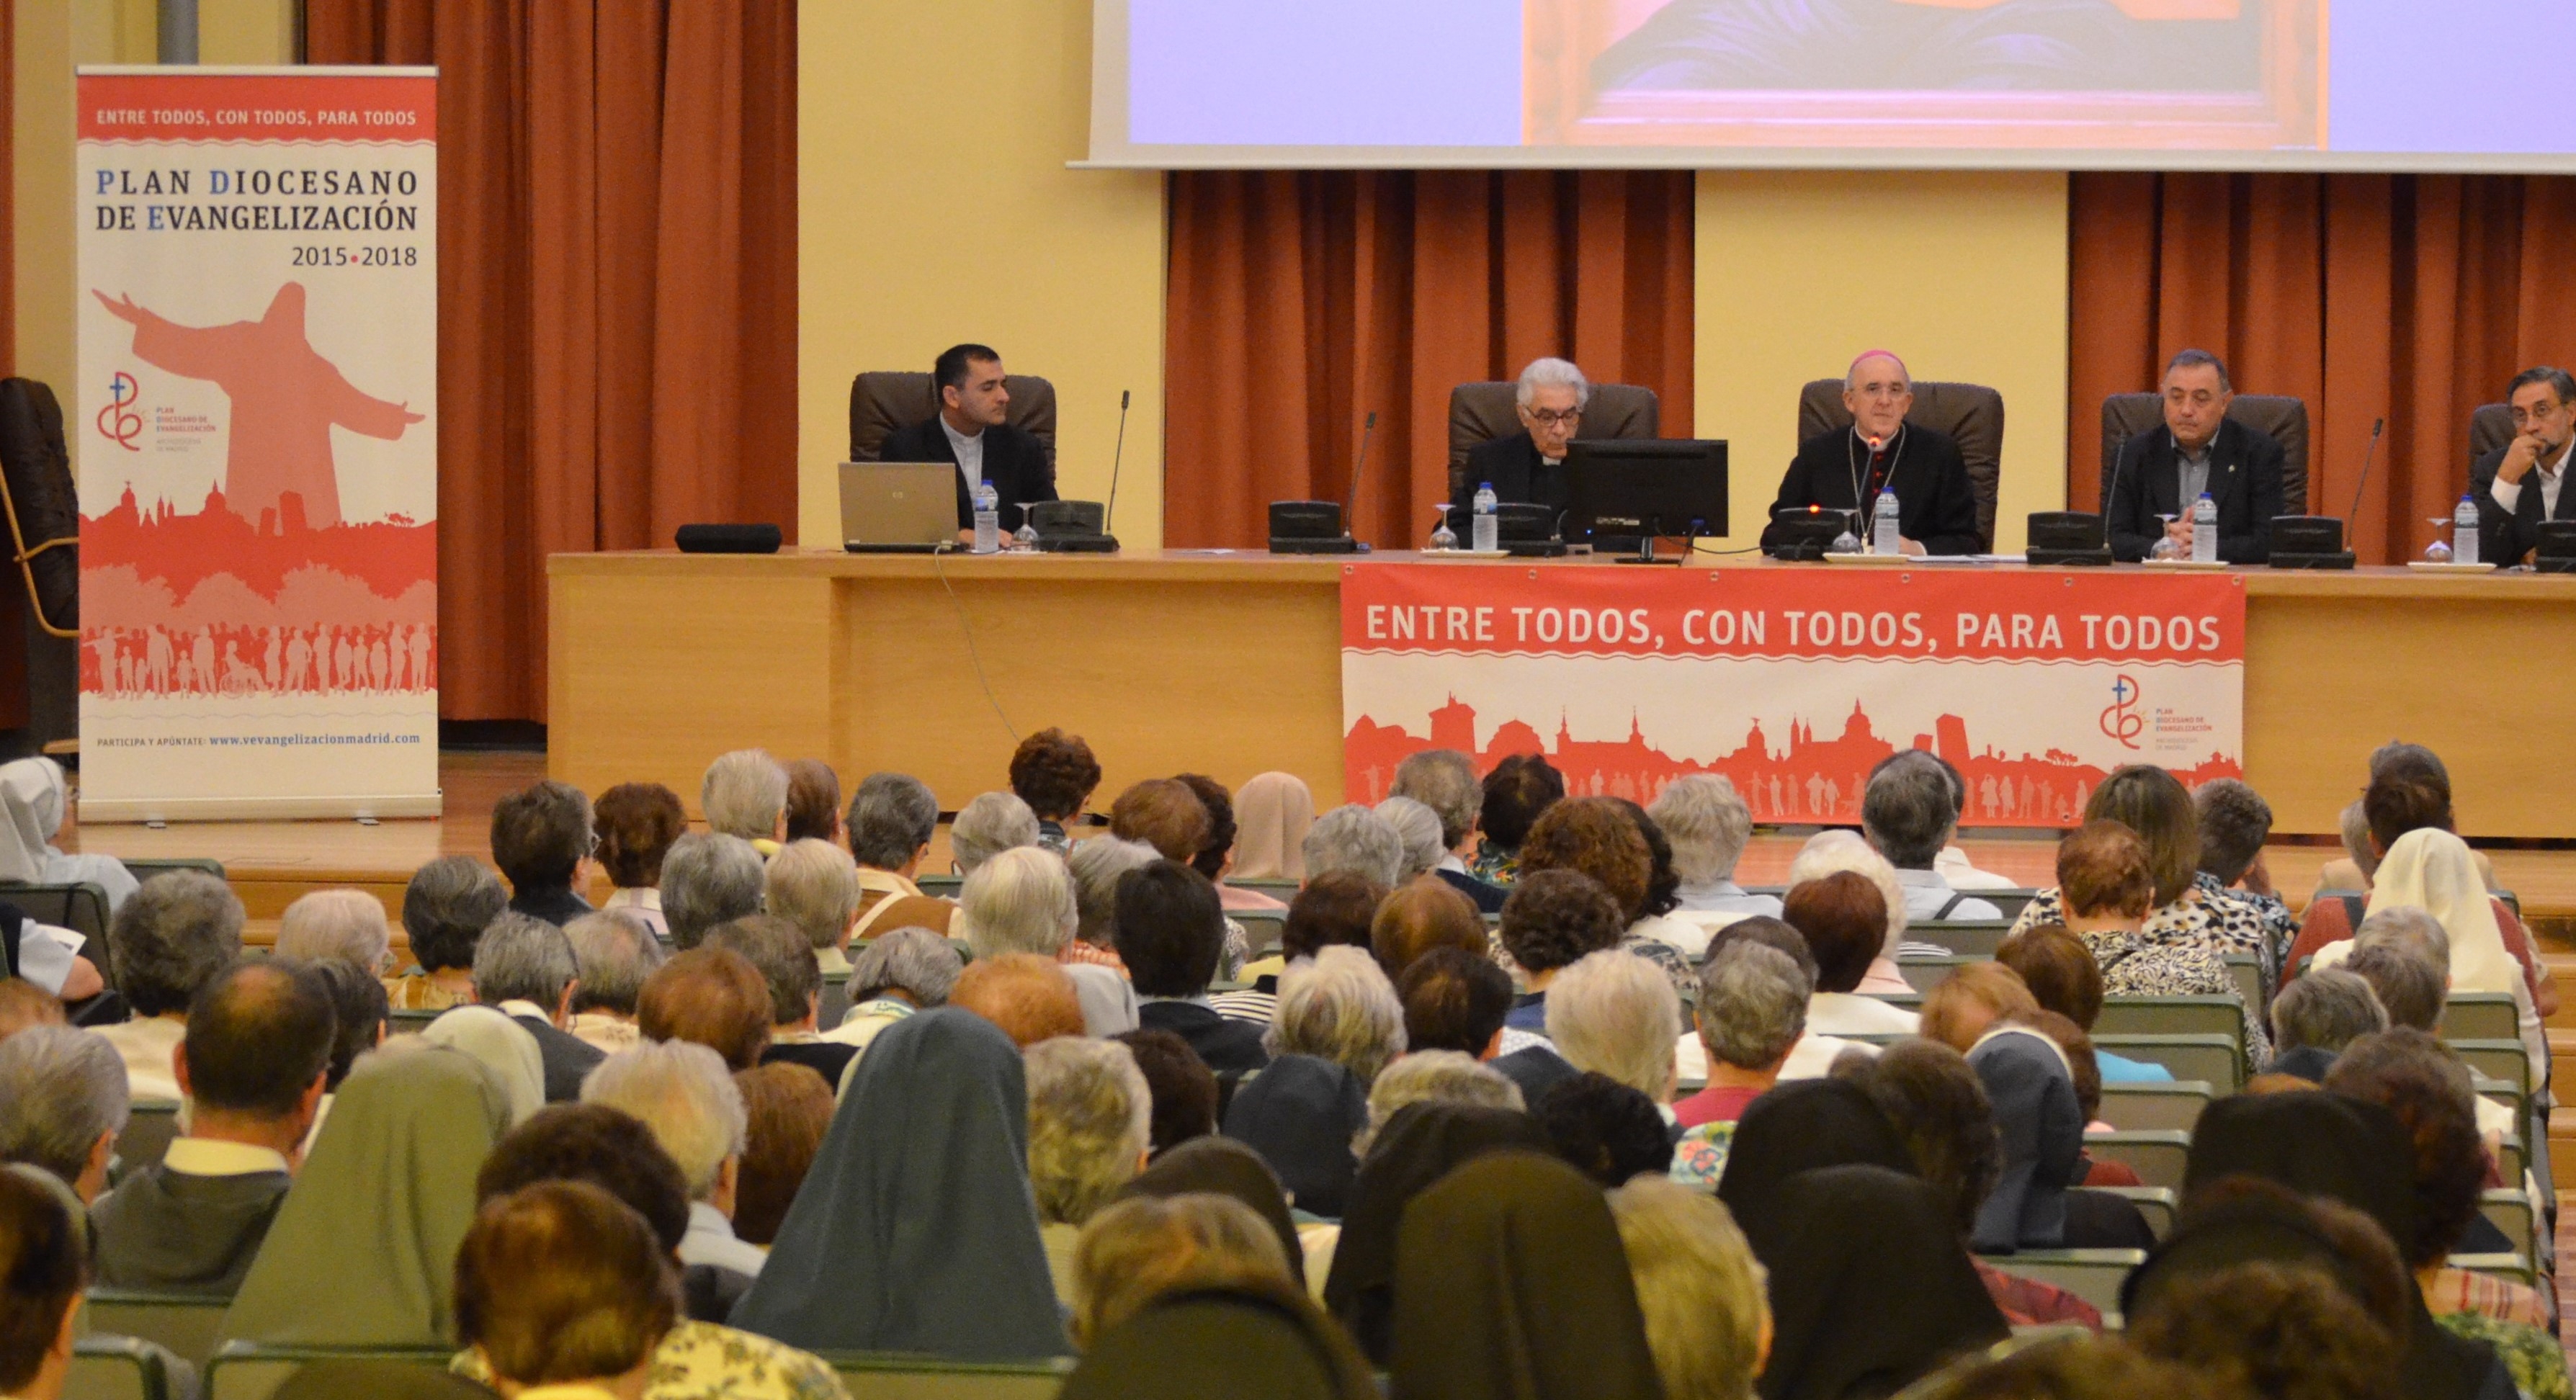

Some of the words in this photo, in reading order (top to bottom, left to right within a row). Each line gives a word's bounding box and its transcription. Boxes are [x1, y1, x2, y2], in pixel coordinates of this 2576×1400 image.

[97, 110, 146, 125] ENTRE
[152, 110, 210, 127] TODOS,
[216, 110, 249, 125] CON
[254, 110, 312, 127] TODOS,
[318, 111, 358, 125] PARA
[364, 111, 416, 126] TODOS
[97, 170, 190, 194] PLAN
[210, 170, 418, 195] DIOCESANO
[96, 206, 135, 230] DE
[147, 199, 418, 230] EVANGELIZACIÓN
[1367, 606, 1495, 642] ENTRE
[1511, 607, 1664, 649] TODOS,
[1682, 610, 1764, 645] CON
[1784, 611, 1938, 653] TODOS,
[1956, 613, 2063, 648] PARA
[2080, 615, 2220, 651] TODOS
[97, 737, 145, 748] PARTICIPA
[157, 736, 207, 746] APÚNTATE:
[209, 732, 421, 748] www.vevangelizacionmadrid.com
